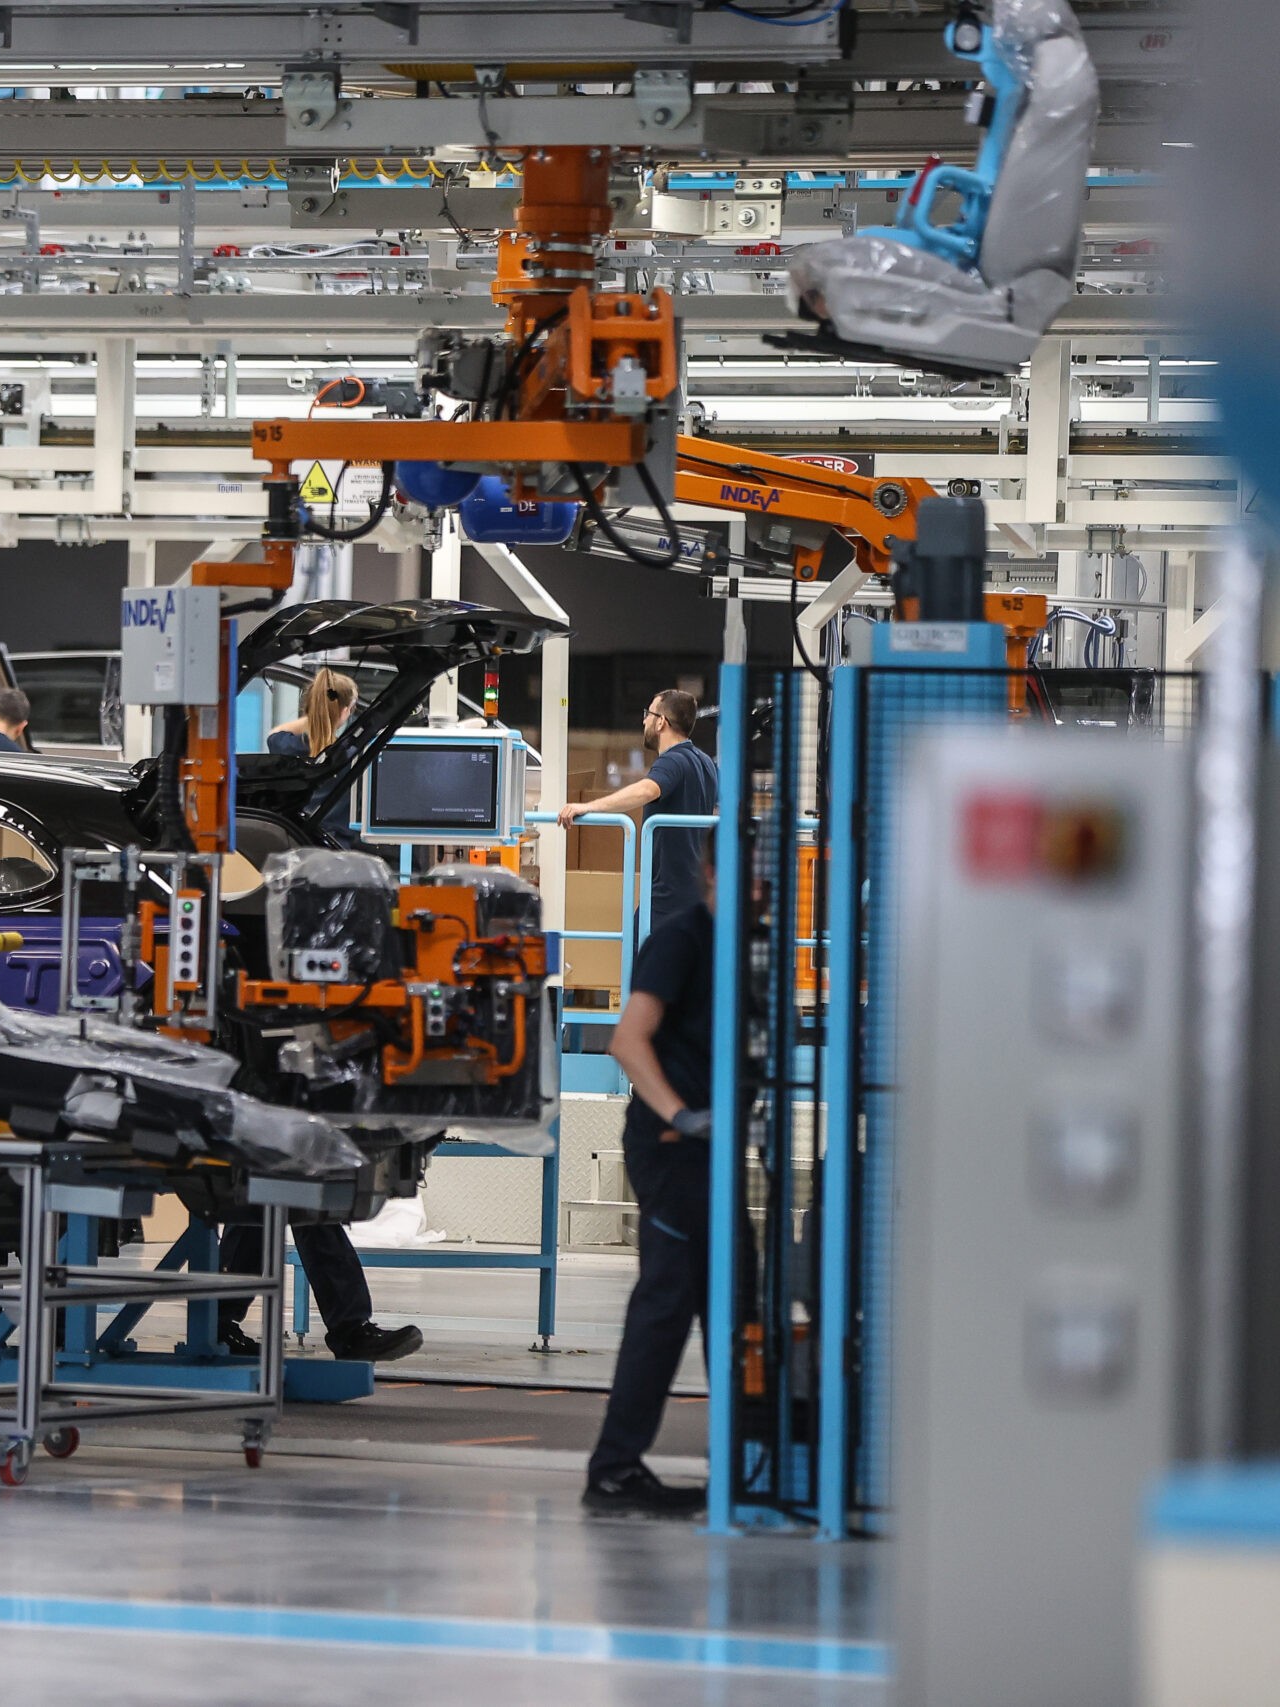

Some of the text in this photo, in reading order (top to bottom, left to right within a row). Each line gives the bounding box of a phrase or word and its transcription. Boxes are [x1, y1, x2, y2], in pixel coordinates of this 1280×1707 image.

[269, 426, 283, 442] 15
[721, 485, 780, 511] INDEVA
[658, 538, 701, 557] INEVA
[122, 590, 175, 633] INDEVA
